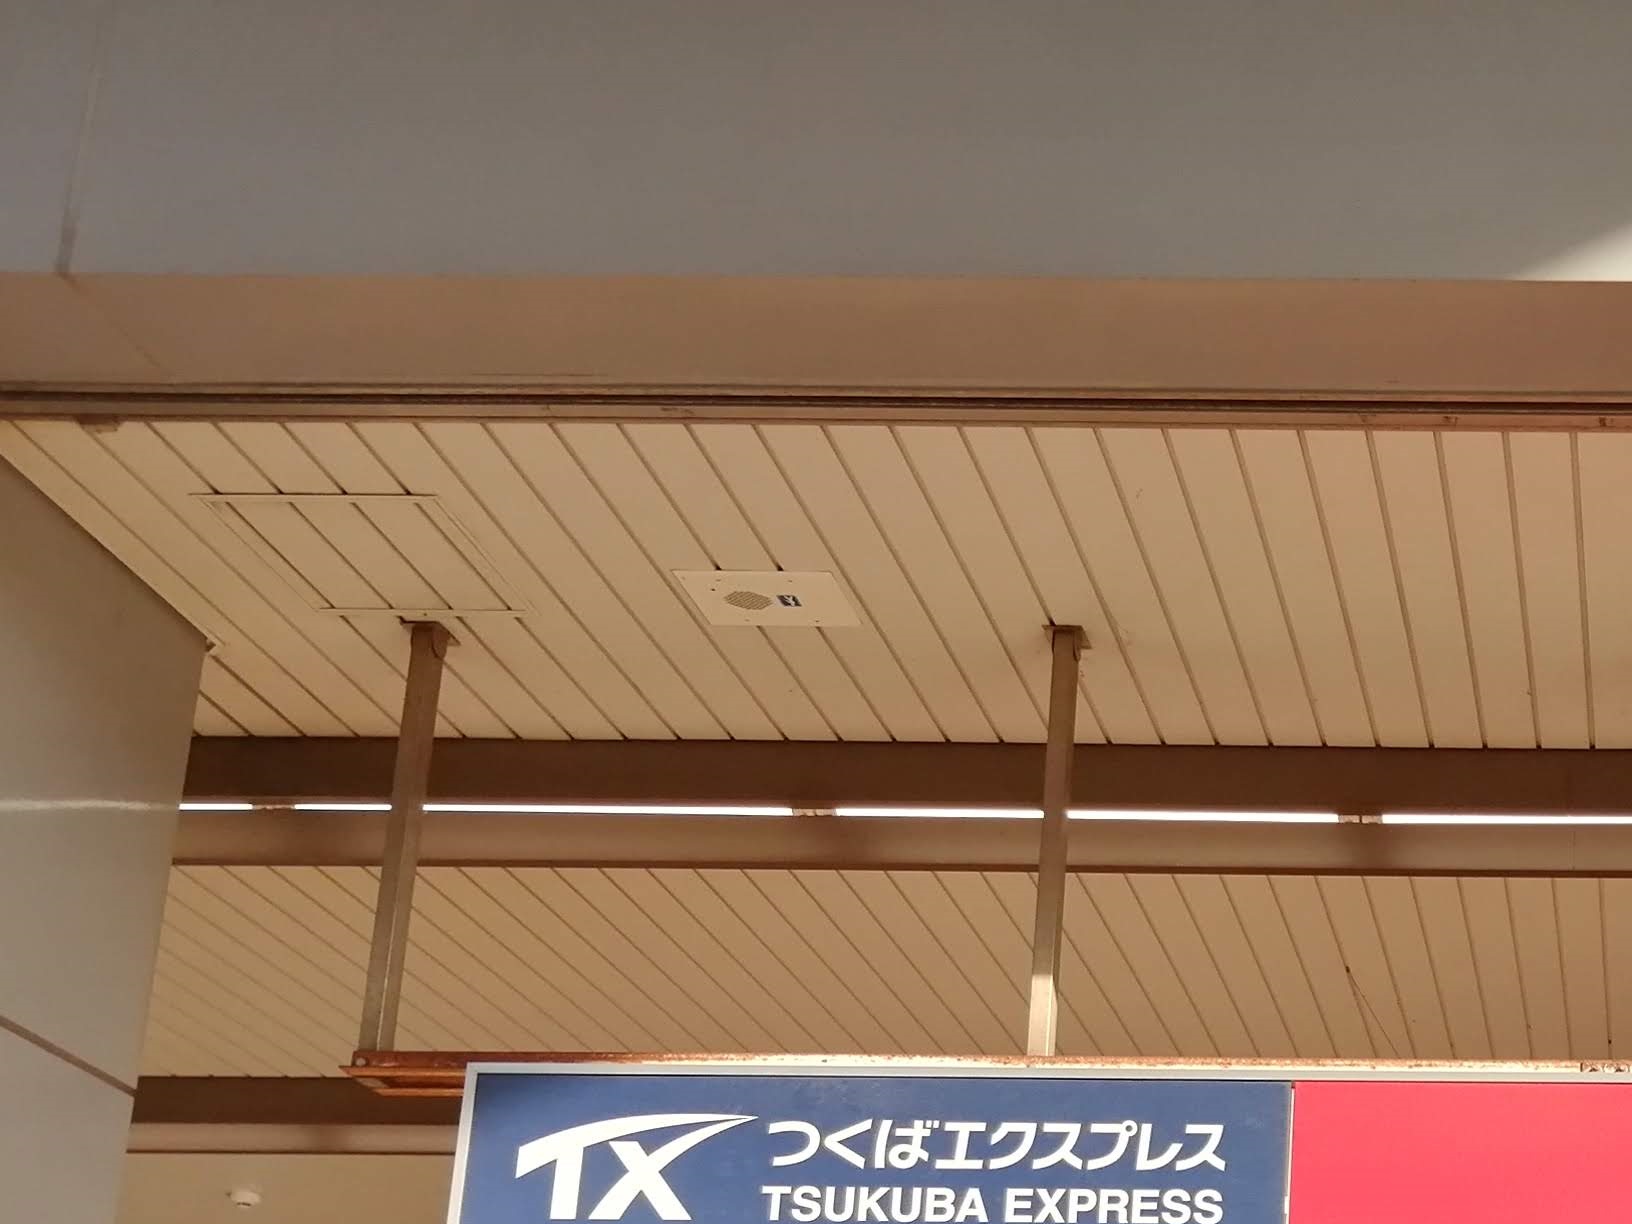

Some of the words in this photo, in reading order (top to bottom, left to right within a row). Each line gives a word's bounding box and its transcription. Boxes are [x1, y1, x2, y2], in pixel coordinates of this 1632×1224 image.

[514, 1112, 759, 1221] TX
[766, 1118, 1226, 1174] つくばエクスプレス
[762, 1185, 989, 1224] TSUKUBA
